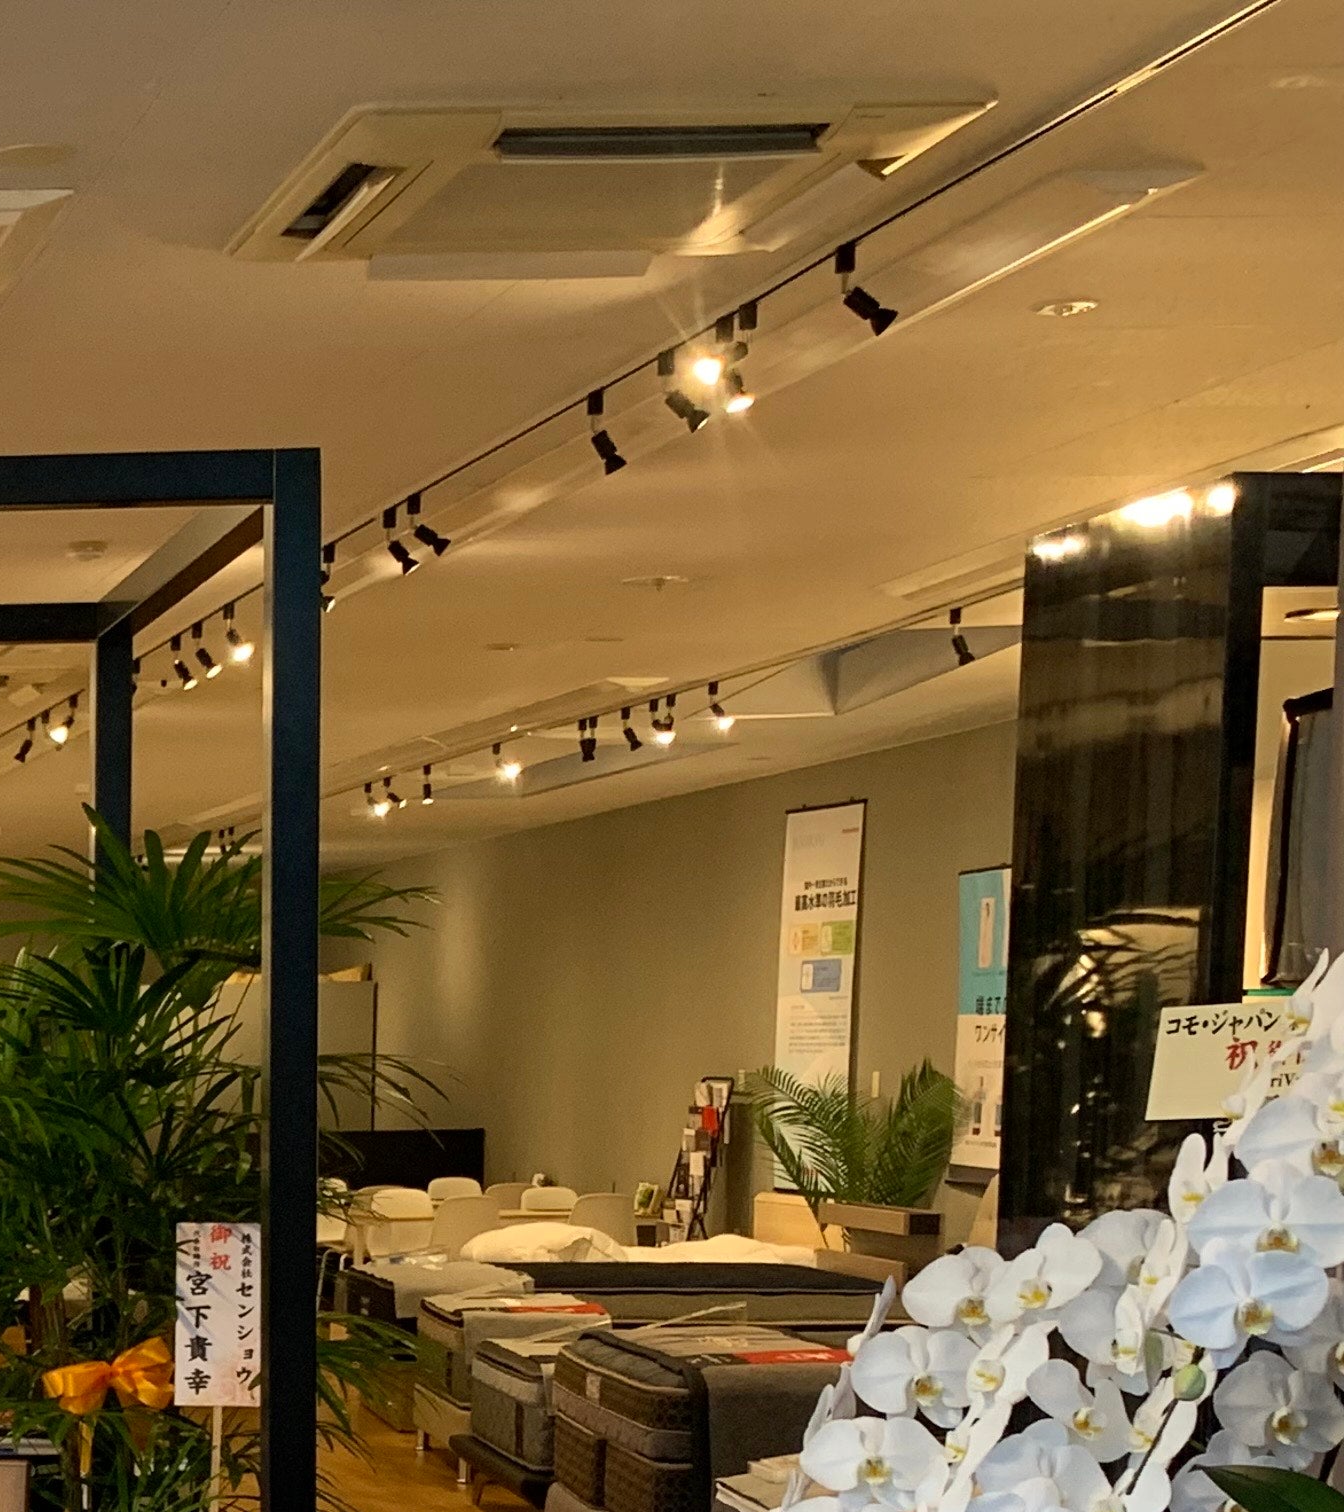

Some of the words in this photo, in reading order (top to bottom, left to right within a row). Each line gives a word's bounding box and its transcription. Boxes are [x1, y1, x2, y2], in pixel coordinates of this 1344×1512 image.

[1166, 1007, 1281, 1036] コモ・ジャパン
[210, 1224, 233, 1270] 御祝
[184, 1270, 213, 1396] 宮下貴幸
